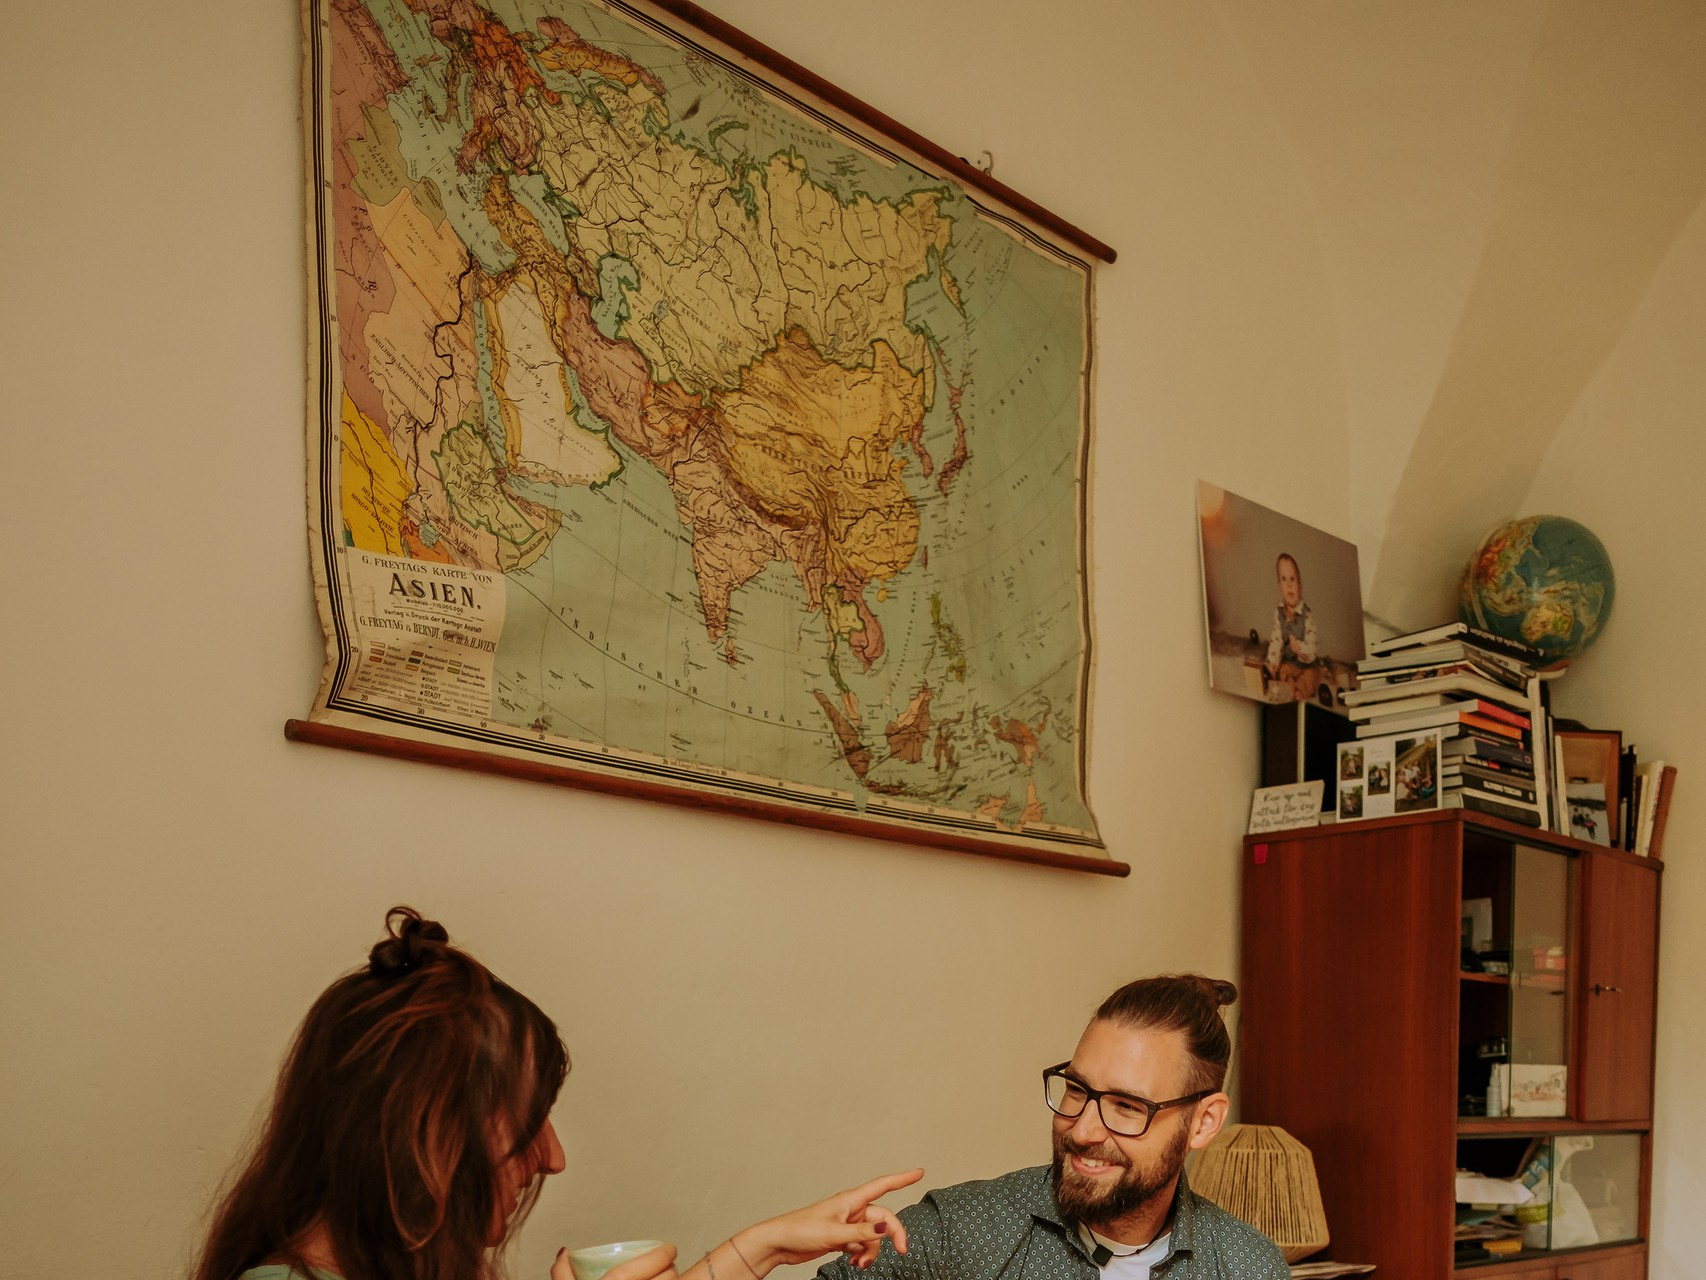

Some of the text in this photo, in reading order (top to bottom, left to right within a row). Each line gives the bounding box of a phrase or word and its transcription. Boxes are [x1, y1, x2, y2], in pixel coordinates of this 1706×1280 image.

[374, 557, 428, 574] FREYTAGS
[432, 567, 467, 580] KARTE
[472, 573, 492, 584] VON
[389, 572, 482, 610] ASIEN.
[383, 609, 404, 618] Verlag
[368, 617, 404, 631] FREYTAG
[424, 690, 441, 699] STADT
